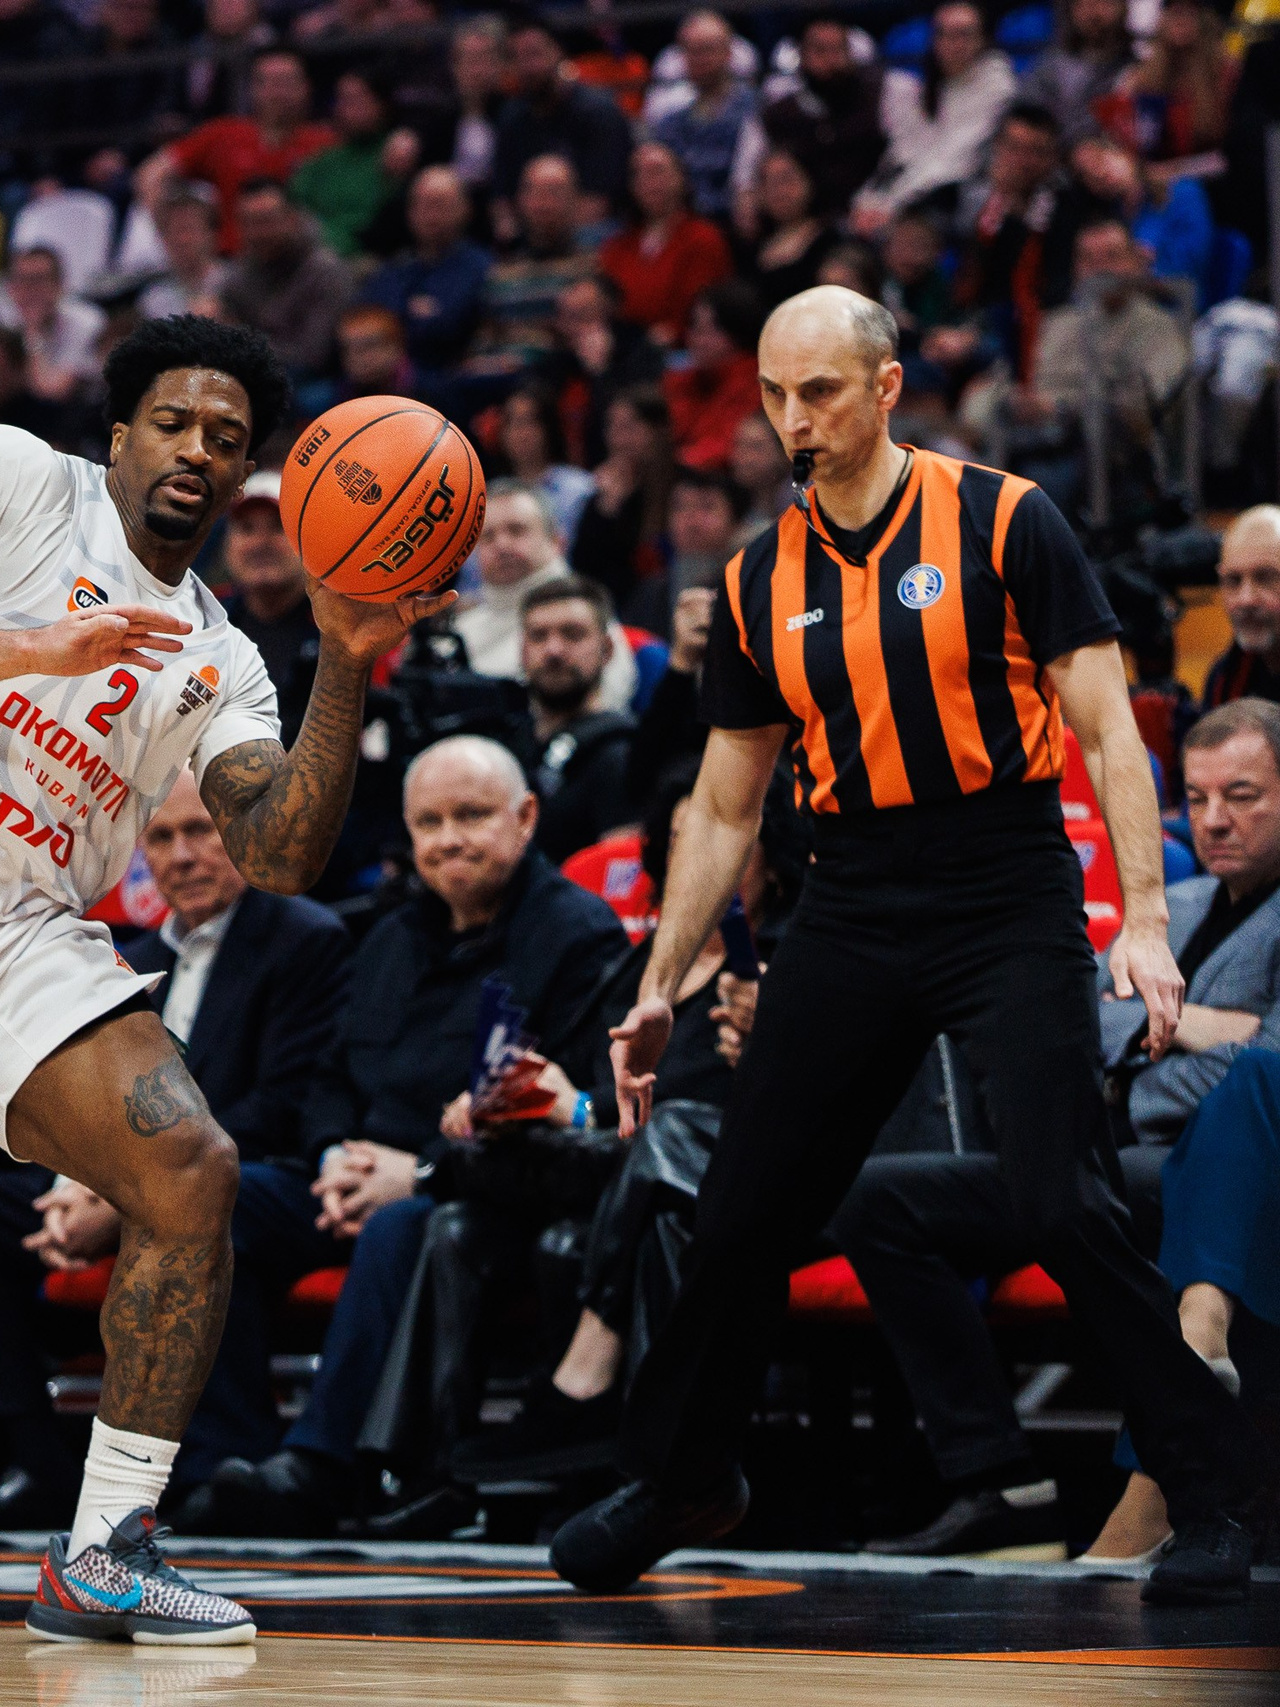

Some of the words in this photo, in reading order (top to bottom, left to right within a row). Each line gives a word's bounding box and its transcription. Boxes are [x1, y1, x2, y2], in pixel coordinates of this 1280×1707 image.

[297, 428, 331, 467] FIBA
[334, 459, 348, 477] CUP
[337, 461, 362, 490] BASKET
[344, 468, 375, 501] WINLINE
[407, 479, 432, 514] OFFICIAL
[389, 515, 409, 536] GAME
[372, 536, 391, 552] BALL
[428, 504, 485, 589] WINLINE
[85, 668, 140, 738] 2
[24, 757, 90, 820] KUBAN
